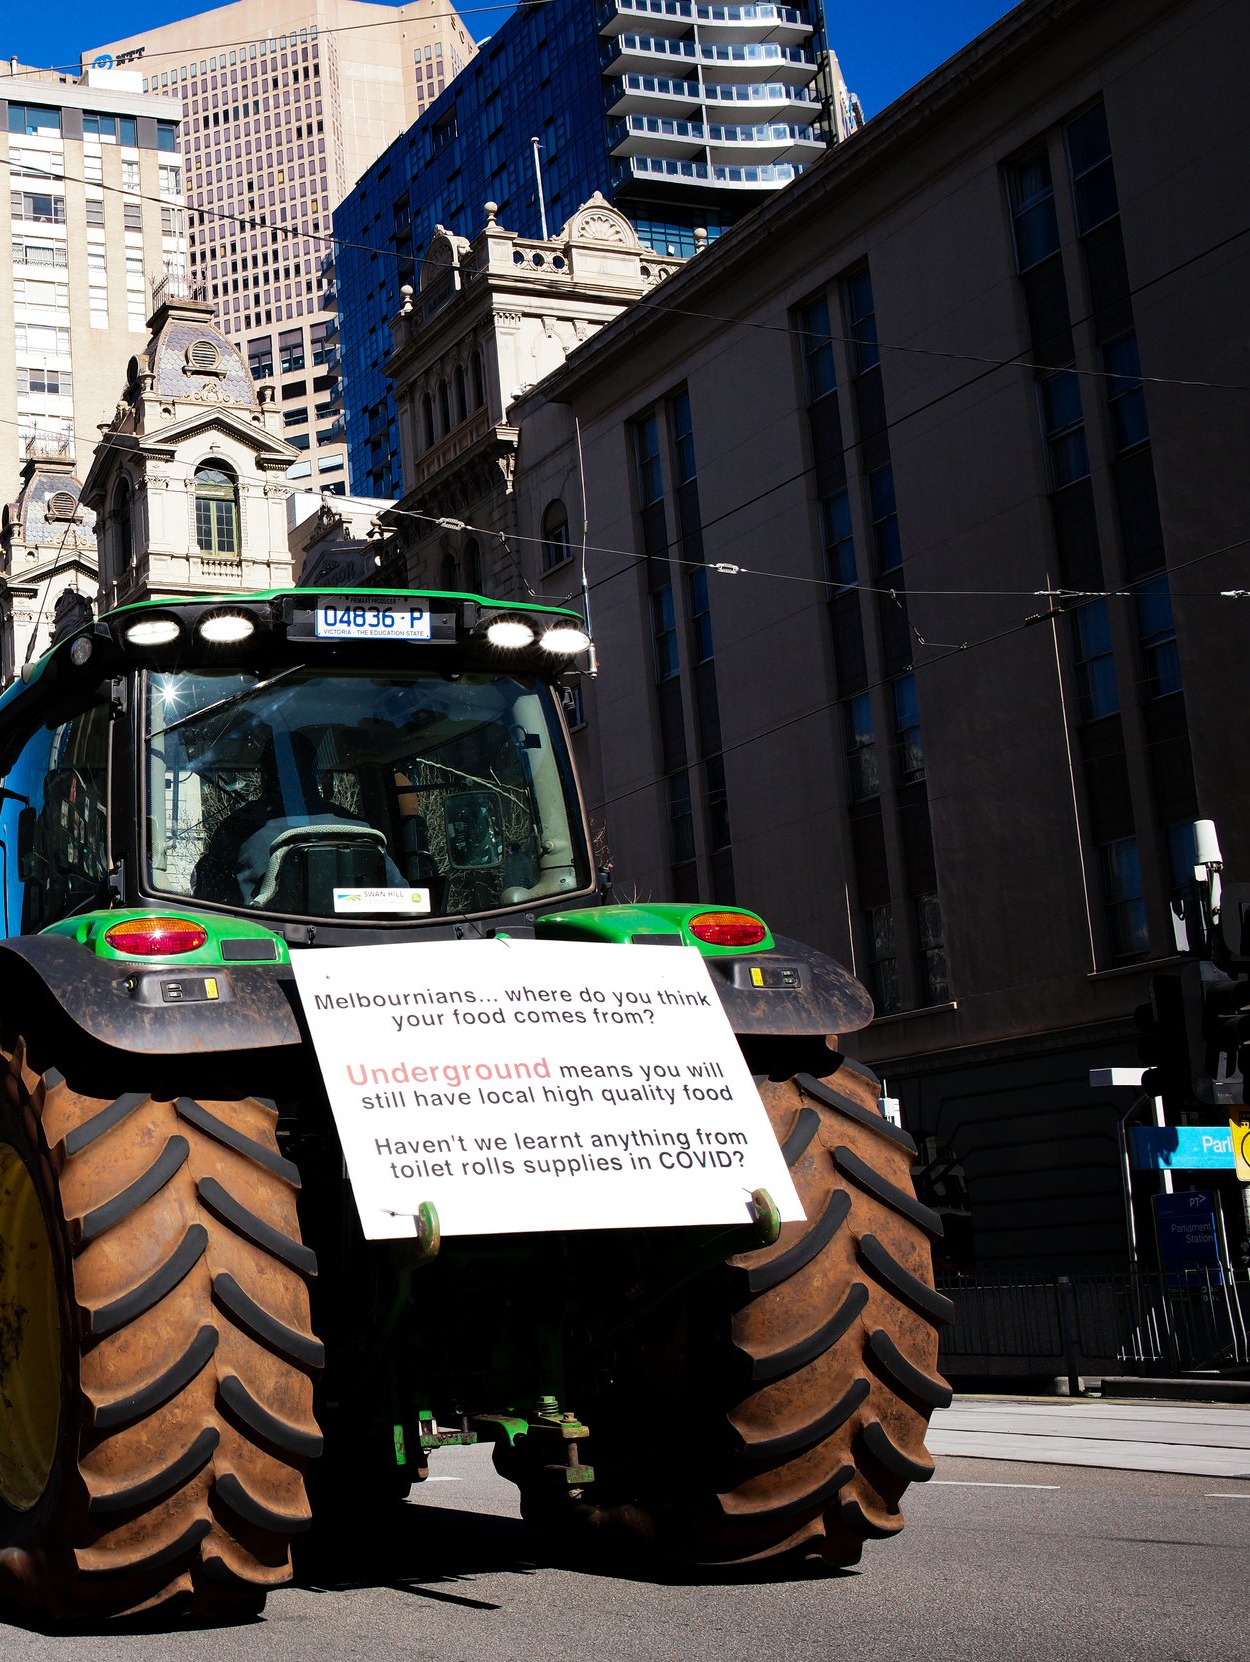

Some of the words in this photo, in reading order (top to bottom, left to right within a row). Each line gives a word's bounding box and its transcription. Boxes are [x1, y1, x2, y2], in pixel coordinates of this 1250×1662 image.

[314, 988, 498, 1010] Melbournians...
[505, 987, 573, 1002] where
[579, 987, 606, 1003] do
[612, 990, 652, 1007] you
[657, 990, 712, 1006] think
[391, 1012, 444, 1032] your
[452, 1008, 506, 1024] food
[514, 1010, 587, 1024] comes
[593, 1008, 655, 1024] from?
[346, 1057, 552, 1087] Underground
[559, 1064, 634, 1079] means
[639, 1064, 681, 1081] you
[686, 1062, 725, 1078] will
[362, 1091, 406, 1109] still
[413, 1090, 471, 1107] have
[478, 1086, 536, 1104] local
[542, 1085, 594, 1106] high
[601, 1084, 675, 1106] quality
[683, 1084, 734, 1101] food
[374, 1135, 468, 1156] Haven't
[474, 1136, 508, 1151] we
[514, 1132, 584, 1150] learnt
[590, 1129, 690, 1151] anything
[696, 1128, 748, 1145] from
[390, 1160, 454, 1179] toilet
[462, 1157, 515, 1175] rolls
[523, 1153, 623, 1177] supplies
[629, 1153, 652, 1170] in
[658, 1150, 745, 1170] COVID?
[1170, 1224, 1212, 1233] Parliament
[1185, 1234, 1214, 1244] Station
